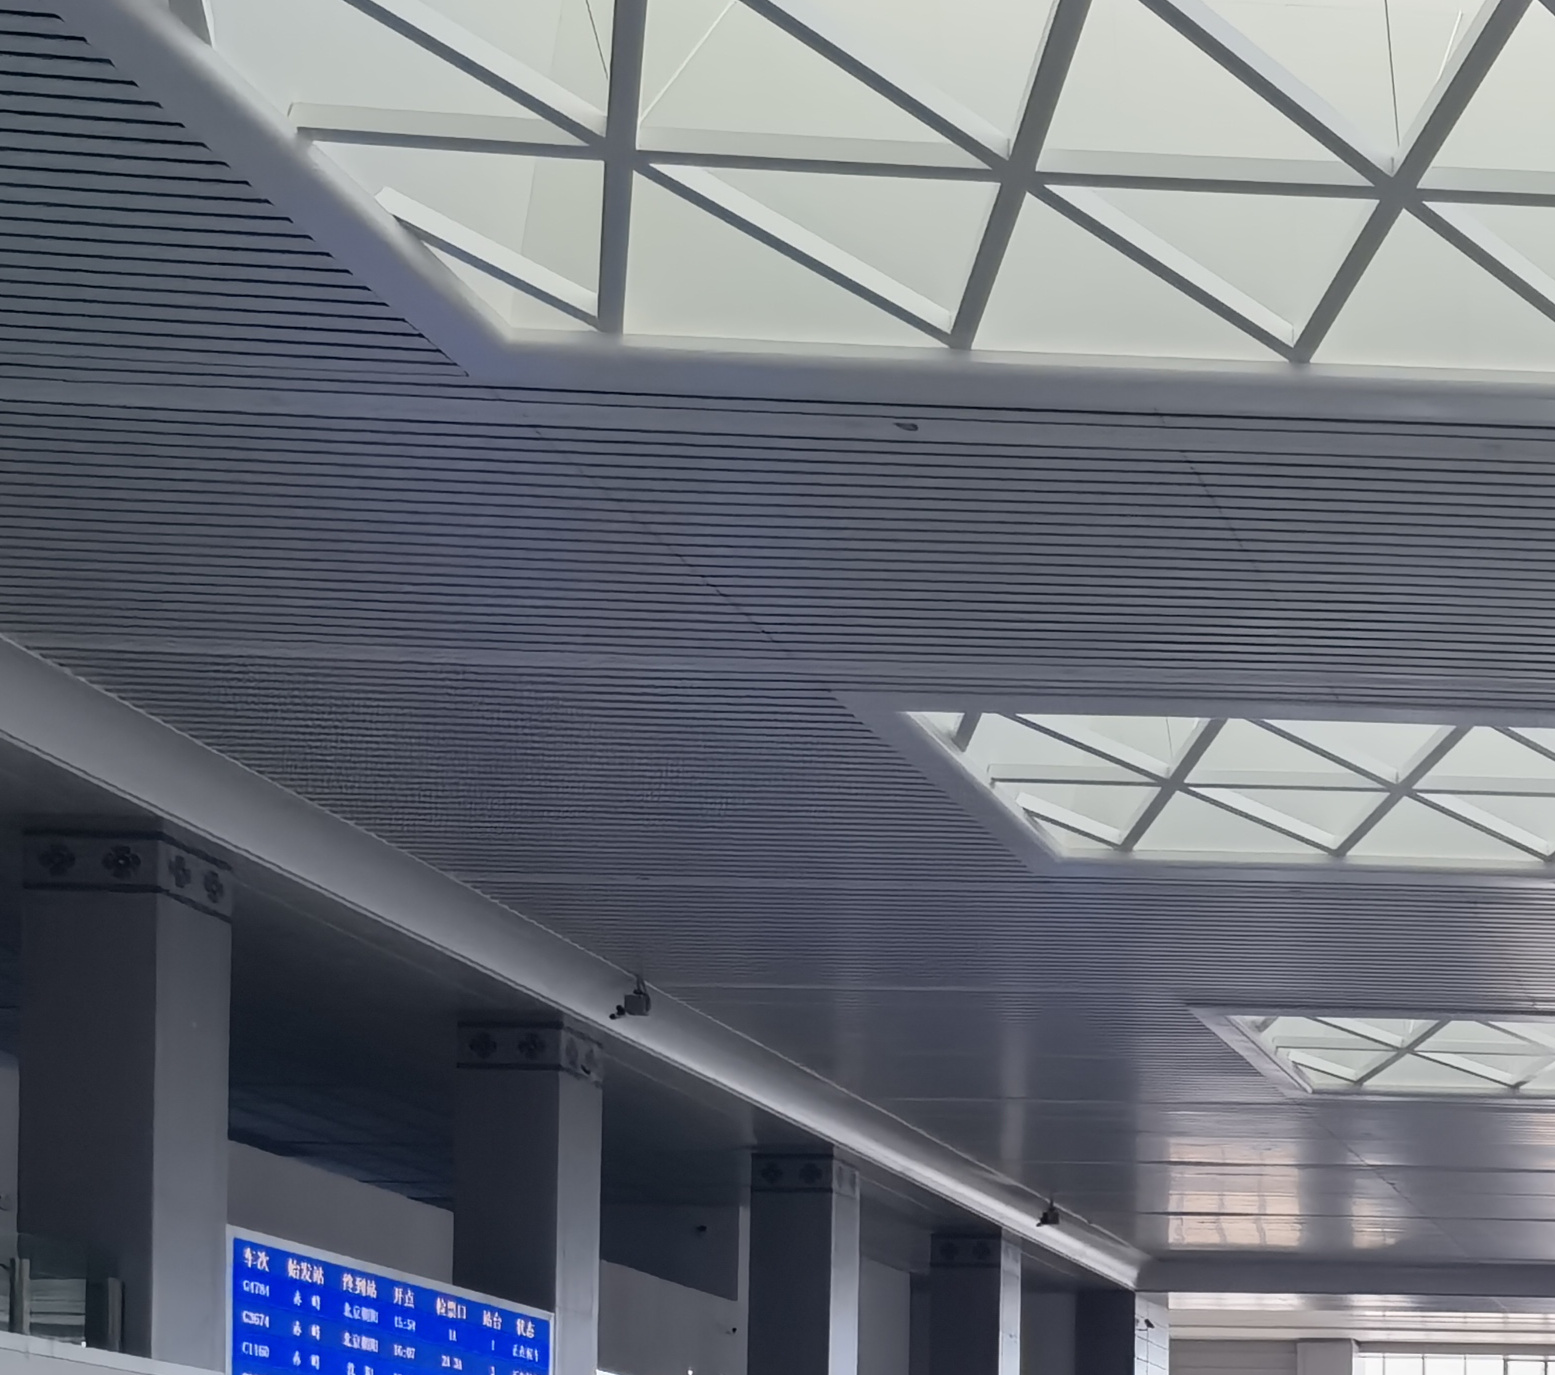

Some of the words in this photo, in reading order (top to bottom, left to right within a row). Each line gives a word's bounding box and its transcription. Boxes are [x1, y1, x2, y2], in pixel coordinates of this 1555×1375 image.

[244, 1247, 269, 1272] 车次
[287, 1258, 324, 1285] 始发站
[342, 1273, 377, 1298] 终到站
[393, 1287, 414, 1308] 开点
[436, 1297, 466, 1319] 检票口
[482, 1310, 502, 1330] 站台
[516, 1318, 535, 1338] 状态
